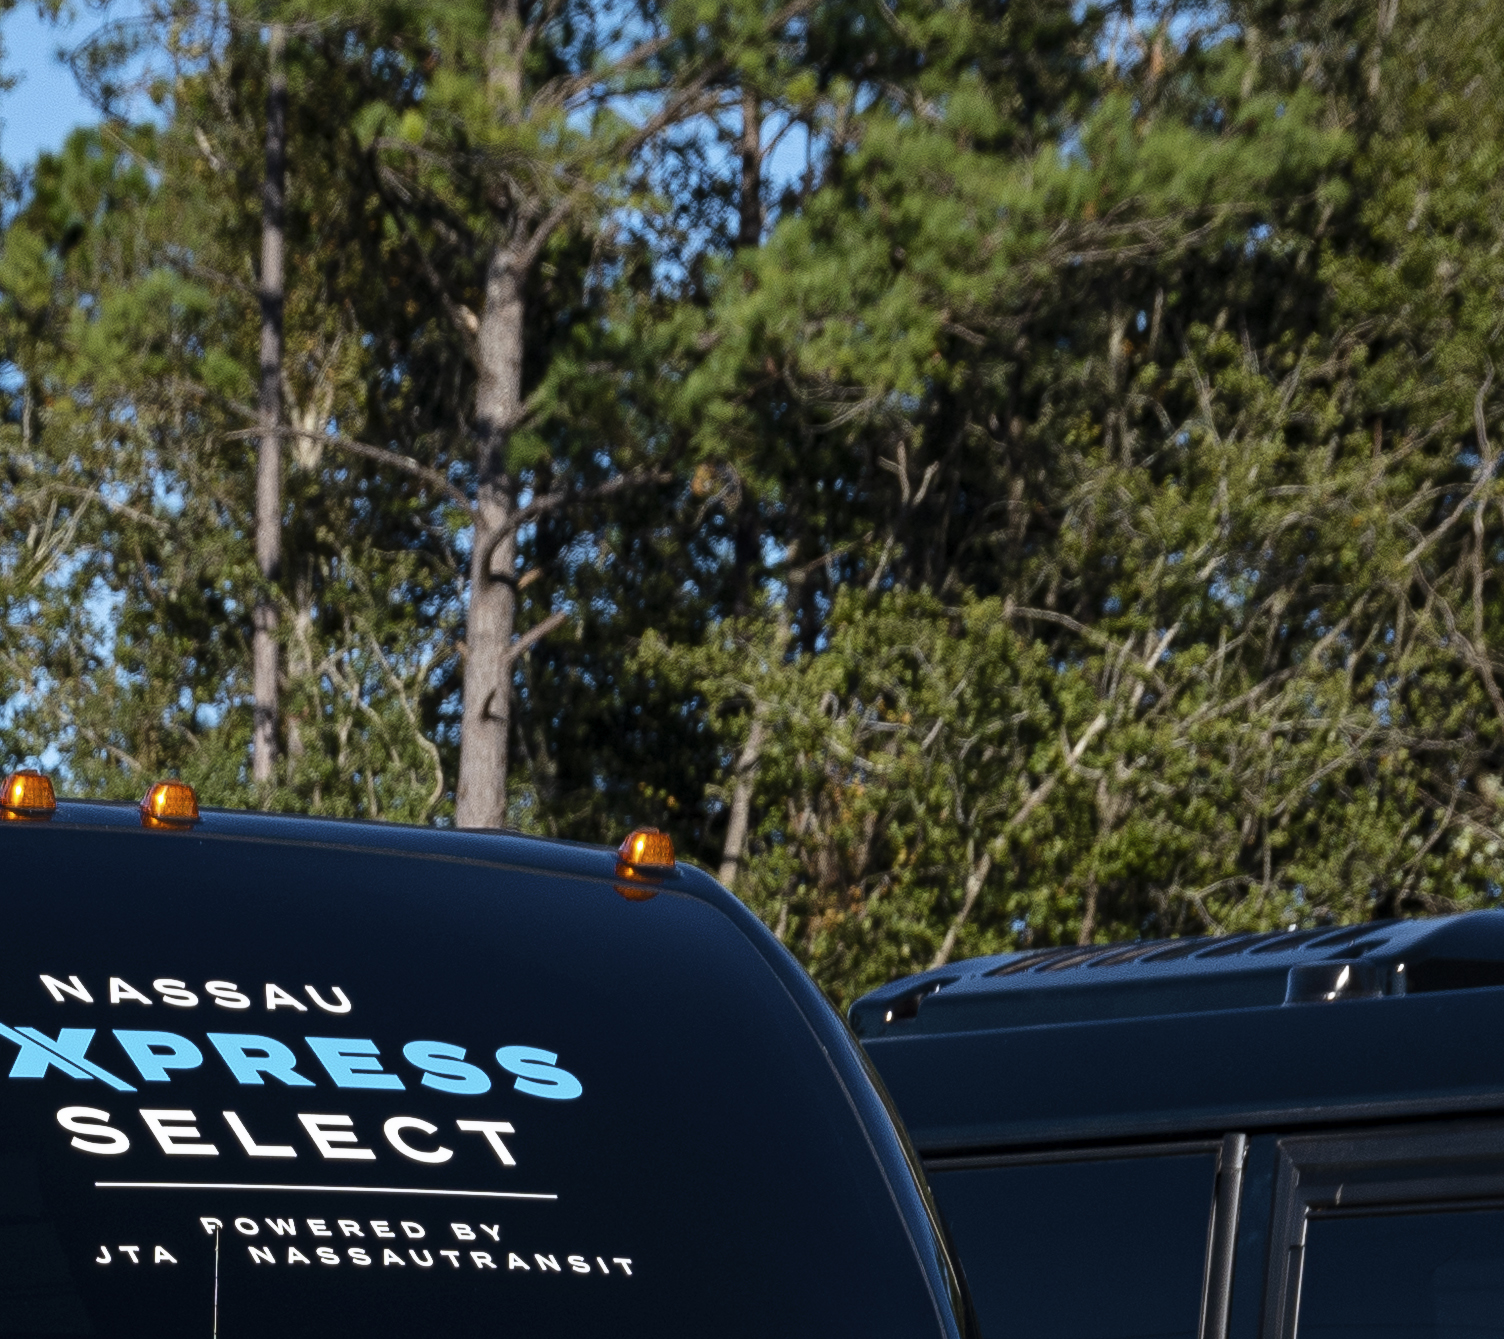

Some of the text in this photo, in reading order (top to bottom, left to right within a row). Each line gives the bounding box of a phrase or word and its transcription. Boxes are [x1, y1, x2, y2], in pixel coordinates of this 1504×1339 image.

[39, 974, 352, 1014] NASSAU
[56, 1105, 517, 1166] SELECT
[199, 1216, 503, 1242] POWERED BY
[95, 1245, 634, 1276] JTA NASSAUTRANSIT
